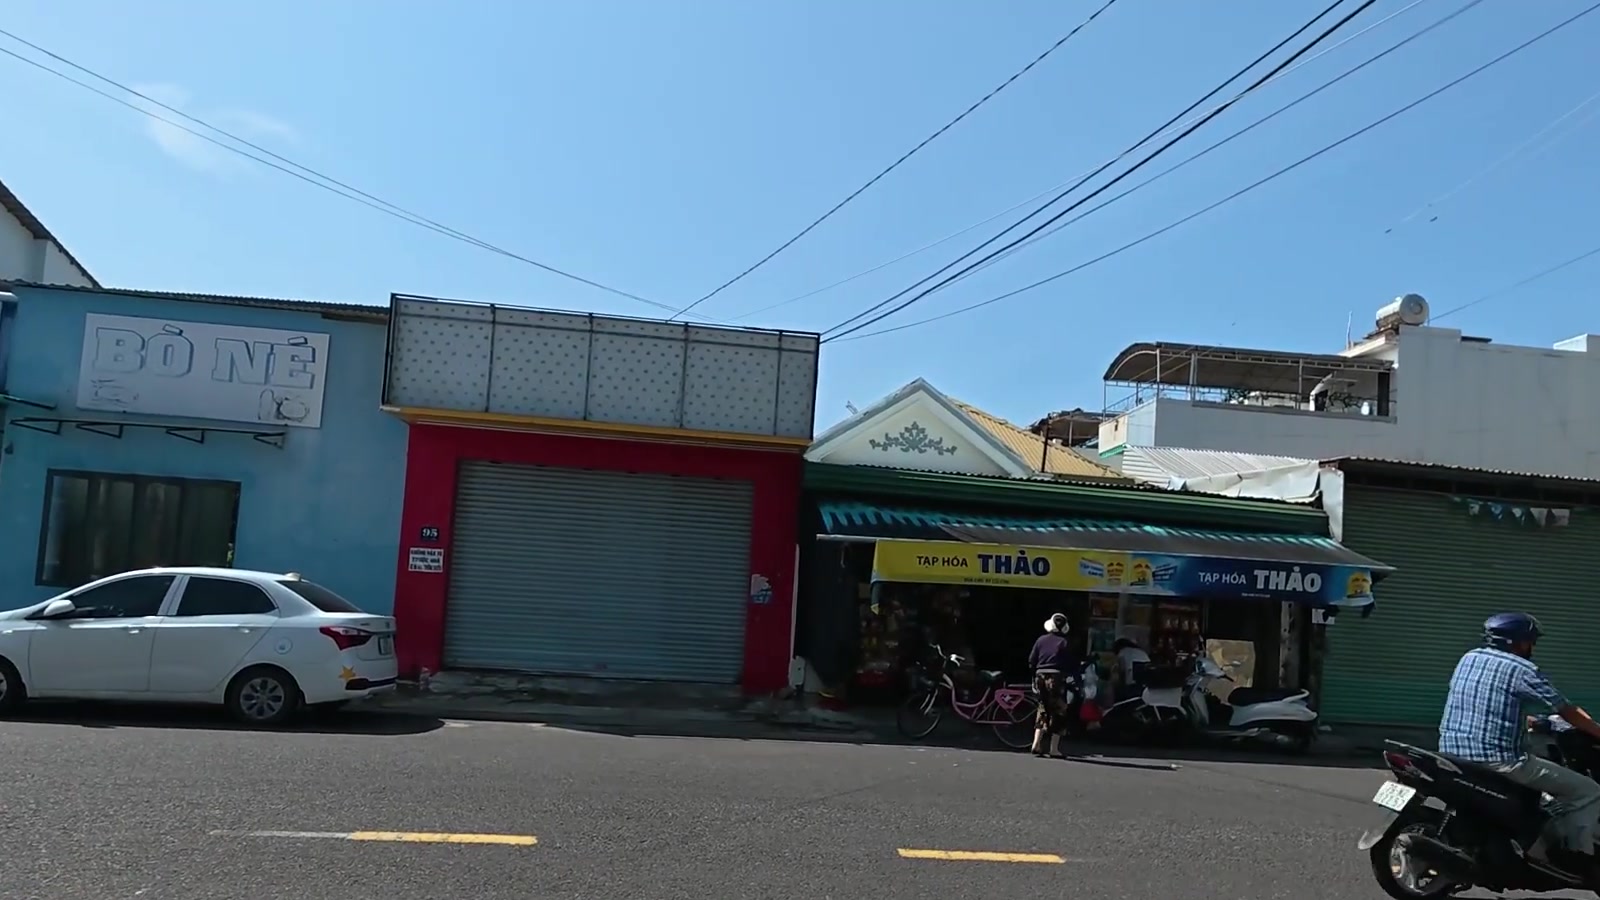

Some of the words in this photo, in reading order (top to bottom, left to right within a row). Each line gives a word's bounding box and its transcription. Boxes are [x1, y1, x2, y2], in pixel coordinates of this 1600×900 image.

[94, 325, 194, 377] BÒ
[213, 337, 316, 389] NÉ
[422, 528, 438, 537] 95
[917, 556, 939, 568] TẠP
[942, 555, 968, 567] HÓA
[978, 550, 1050, 576] THẢO
[1198, 573, 1220, 585] TẠP
[1222, 572, 1246, 584] HÓA
[1254, 567, 1321, 592] THẢO
